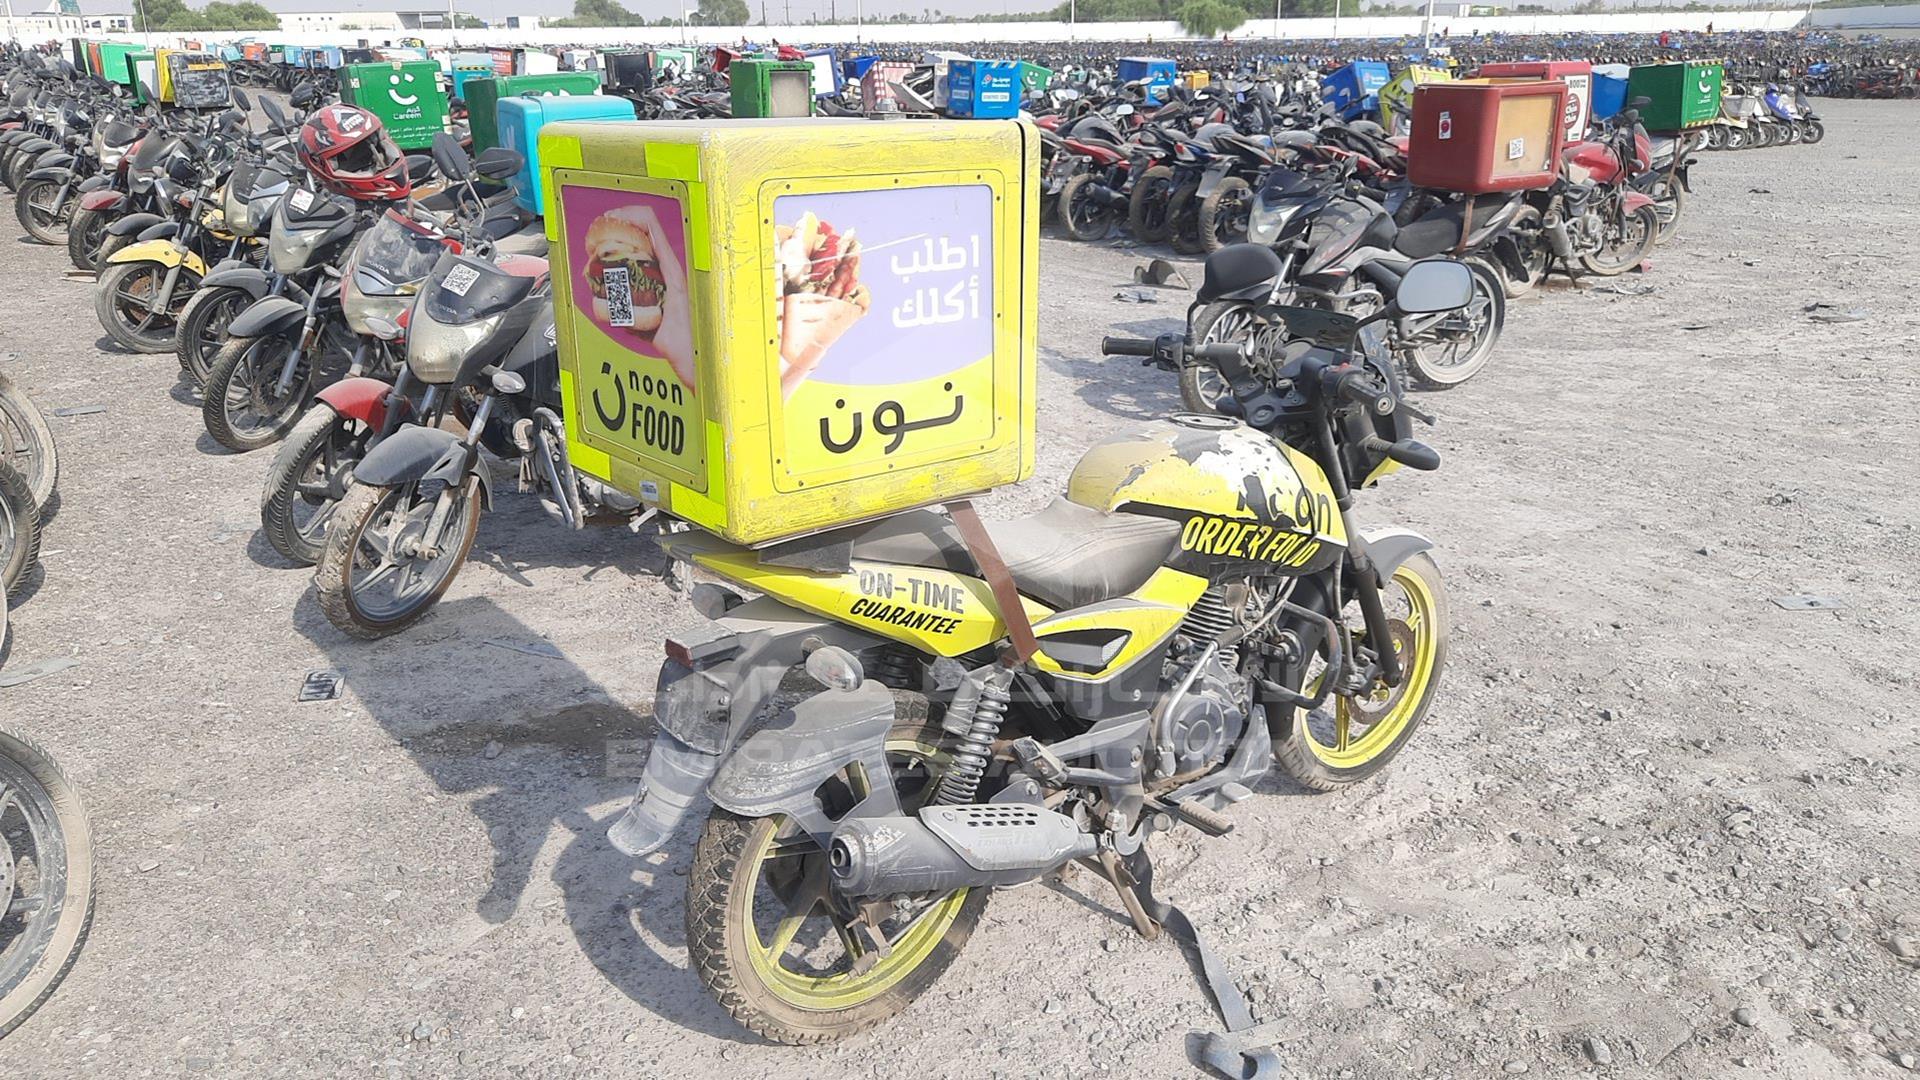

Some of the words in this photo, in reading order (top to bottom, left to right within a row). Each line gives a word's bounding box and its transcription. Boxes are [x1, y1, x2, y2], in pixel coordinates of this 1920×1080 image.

[890, 234, 980, 285] اطلب
[891, 274, 980, 329] أكلك
[628, 369, 683, 406] noon
[631, 402, 685, 456] FOOD
[819, 381, 964, 455] نون
[1180, 515, 1273, 561] ORDER
[859, 569, 965, 614] ON-TIME
[849, 598, 963, 635] GUARANTEE
